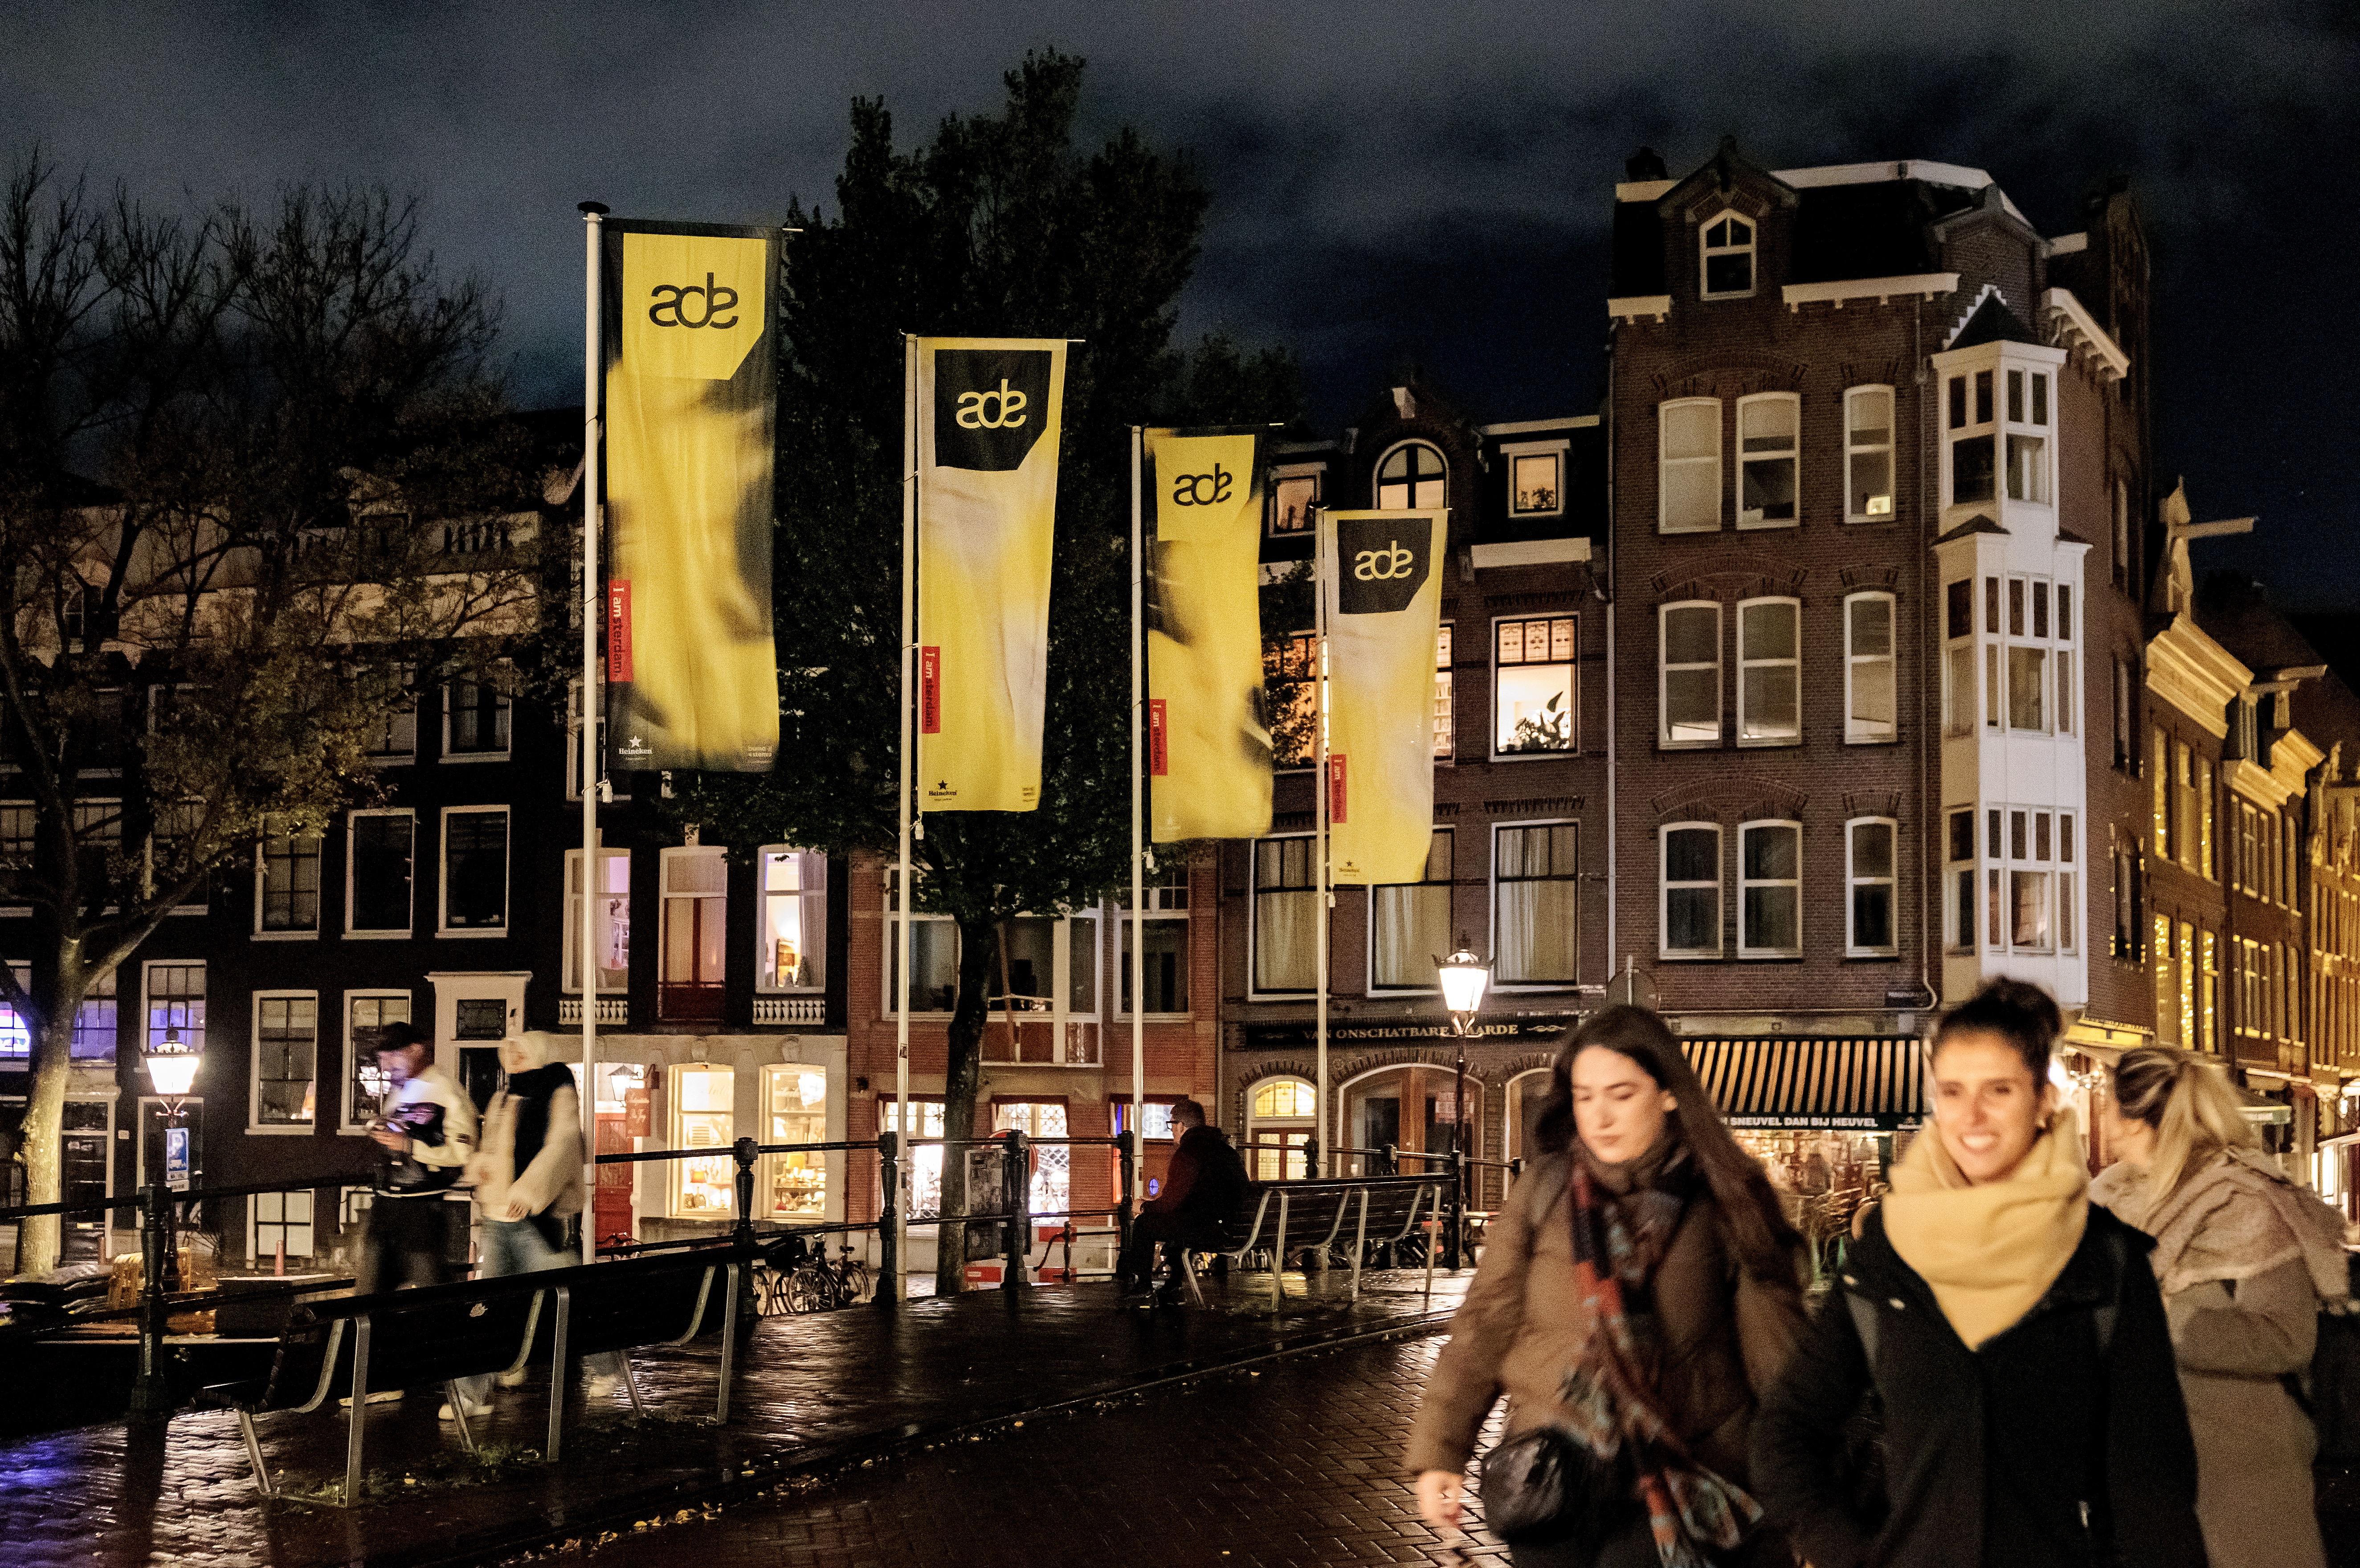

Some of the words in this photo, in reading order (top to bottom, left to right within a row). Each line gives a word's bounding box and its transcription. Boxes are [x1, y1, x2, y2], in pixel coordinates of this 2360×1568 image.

[1336, 1026, 1449, 1038] ONSCHATBARE
[1730, 1117, 1782, 1126] SNEUVEL
[1784, 1117, 1809, 1126] DAN
[1810, 1117, 1829, 1126] BIJ
[1832, 1117, 1878, 1127] HEUVEL
